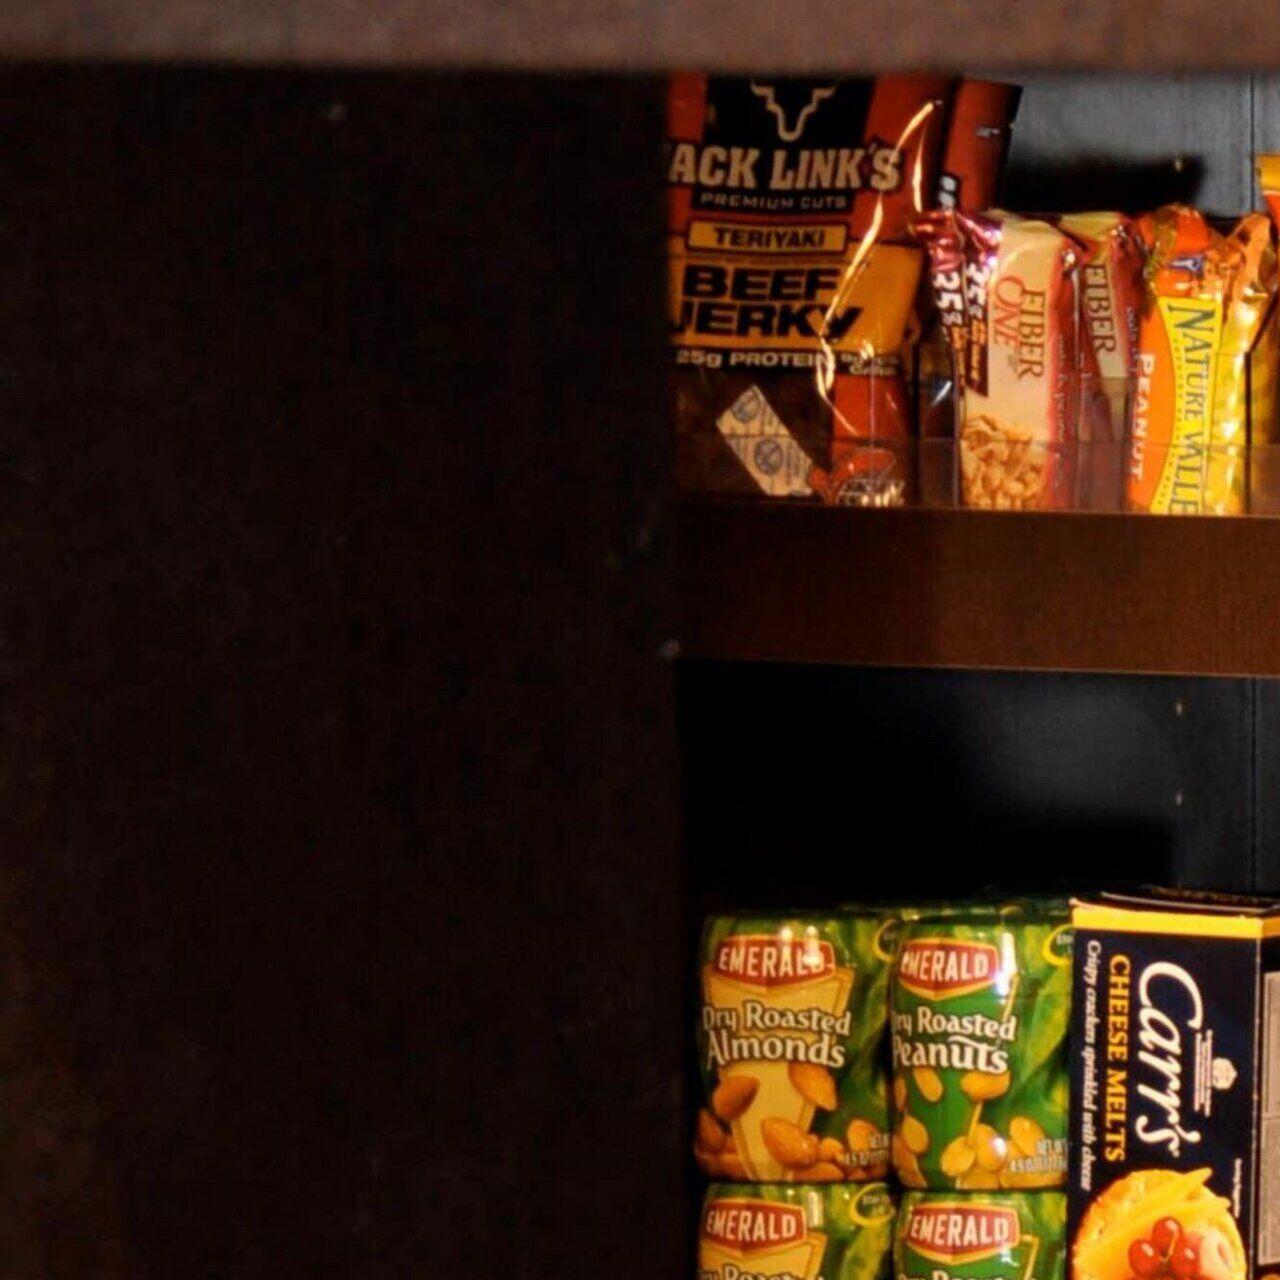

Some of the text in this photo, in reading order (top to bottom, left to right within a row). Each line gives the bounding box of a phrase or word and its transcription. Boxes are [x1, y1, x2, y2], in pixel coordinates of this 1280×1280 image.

[668, 143, 901, 191] ACK LINK'S
[700, 193, 848, 209] PREMIUM CUTS
[714, 227, 826, 249] TERIYAKI
[683, 264, 843, 301] BEEF
[671, 301, 864, 342] JERKY
[993, 276, 1026, 348] ONE
[1083, 263, 1117, 353] FIBER
[1016, 287, 1045, 379] FIBER
[729, 351, 834, 368] PROTEIN
[1167, 304, 1216, 422] NATURE
[1130, 353, 1155, 482] PEANUT
[717, 946, 826, 977] EMERALD
[745, 1001, 853, 1036] Roasted
[917, 1005, 1017, 1042] Roasted
[706, 1031, 846, 1070] Almonds
[893, 1035, 1010, 1075] Peanuts
[1080, 940, 1102, 1191] Crispy crackers sprinkled with cheese
[1105, 955, 1131, 1163] CHEESE MELTS
[1136, 961, 1203, 1158] Carr's
[706, 1211, 797, 1239] EMERALD
[909, 1212, 1010, 1243] EMERALD
